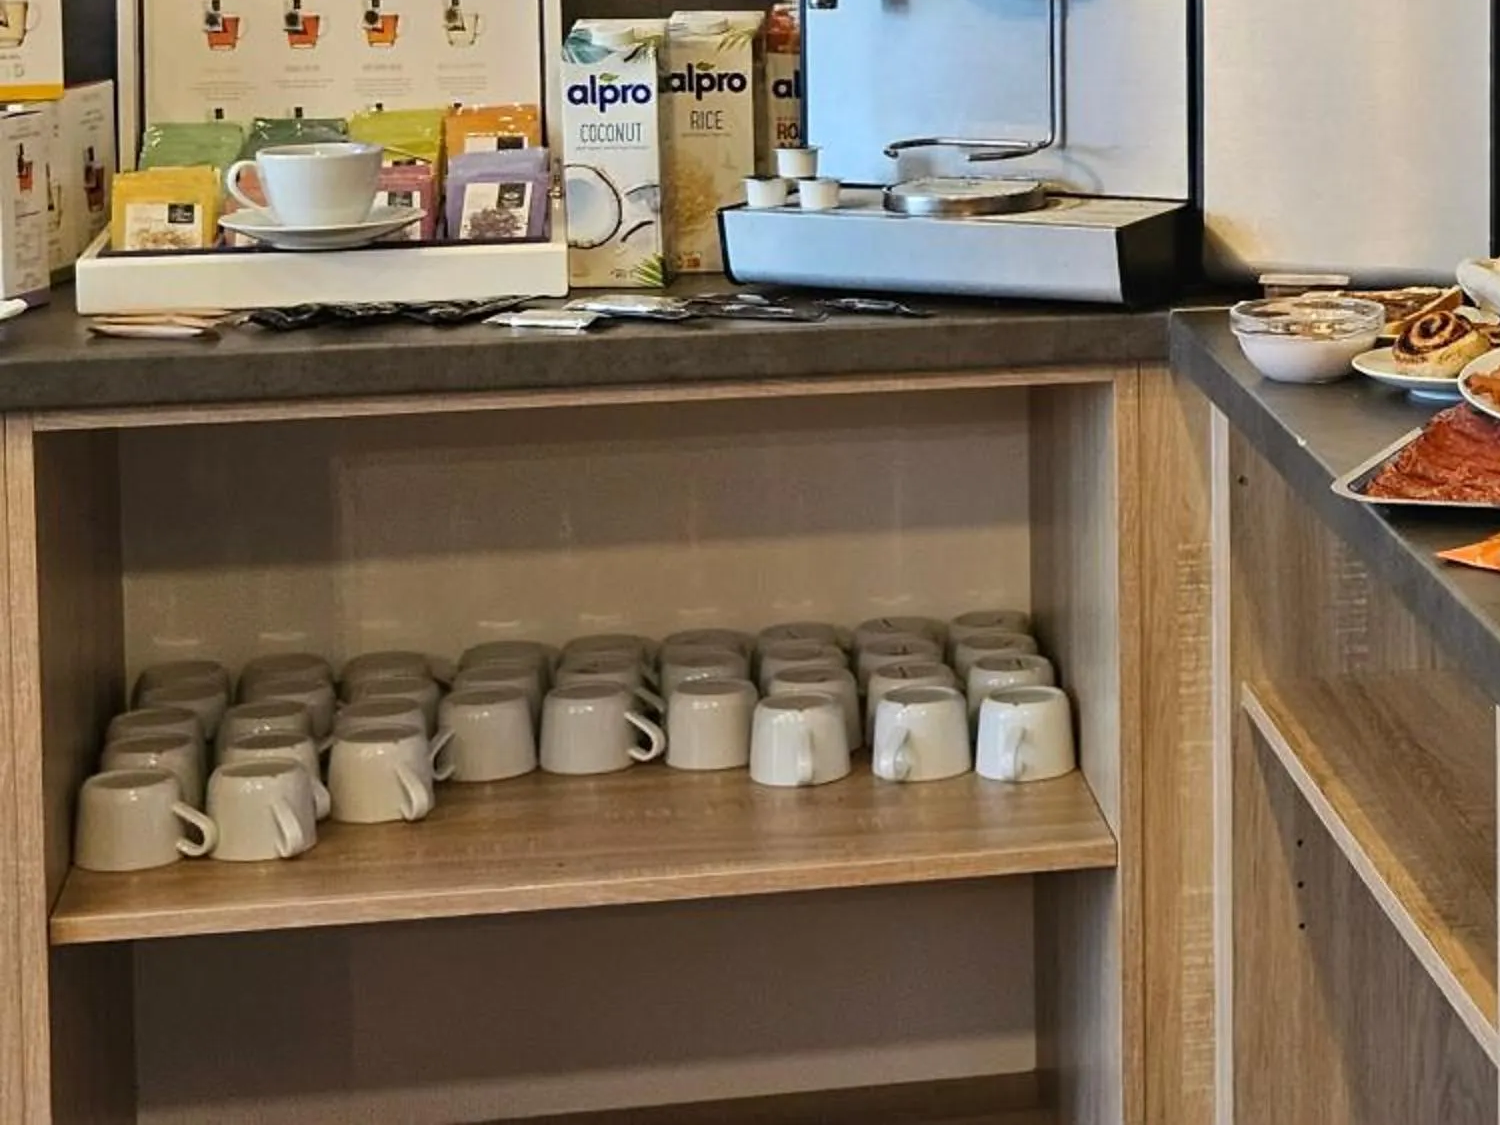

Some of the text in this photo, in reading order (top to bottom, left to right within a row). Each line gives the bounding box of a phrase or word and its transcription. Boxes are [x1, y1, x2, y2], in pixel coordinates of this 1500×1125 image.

[567, 74, 652, 113] alpro
[667, 62, 747, 101] alpro
[579, 122, 643, 144] COCONUT
[689, 110, 725, 131] RICE
